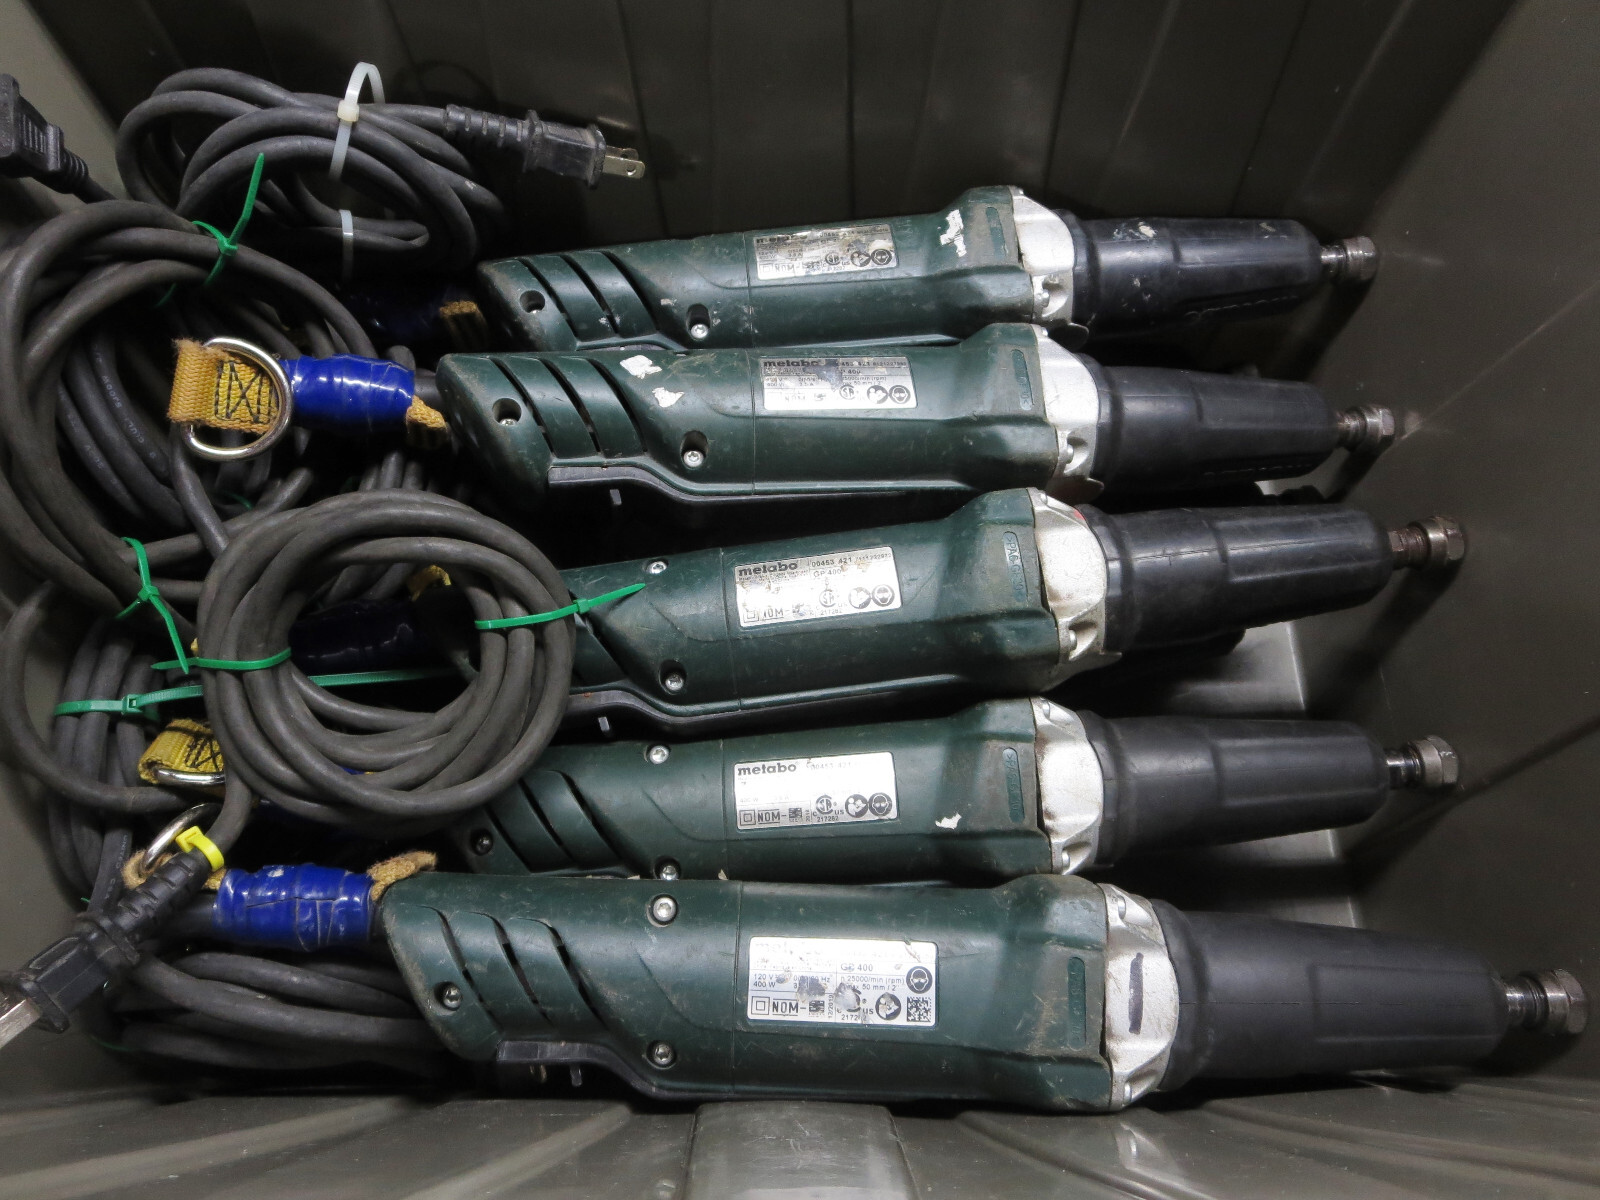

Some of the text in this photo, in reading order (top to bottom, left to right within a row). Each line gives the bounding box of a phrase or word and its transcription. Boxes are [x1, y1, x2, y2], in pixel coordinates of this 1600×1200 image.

[812, 559, 834, 568] 00453
[738, 562, 798, 576] metabo
[813, 570, 826, 578] GP
[827, 568, 842, 576] 400
[738, 762, 796, 776] metabo
[758, 811, 780, 822] NOM
[857, 964, 874, 972] 400
[848, 975, 884, 984] 25000/min
[885, 977, 905, 985] (rpm)
[772, 1001, 799, 1014] NOM
